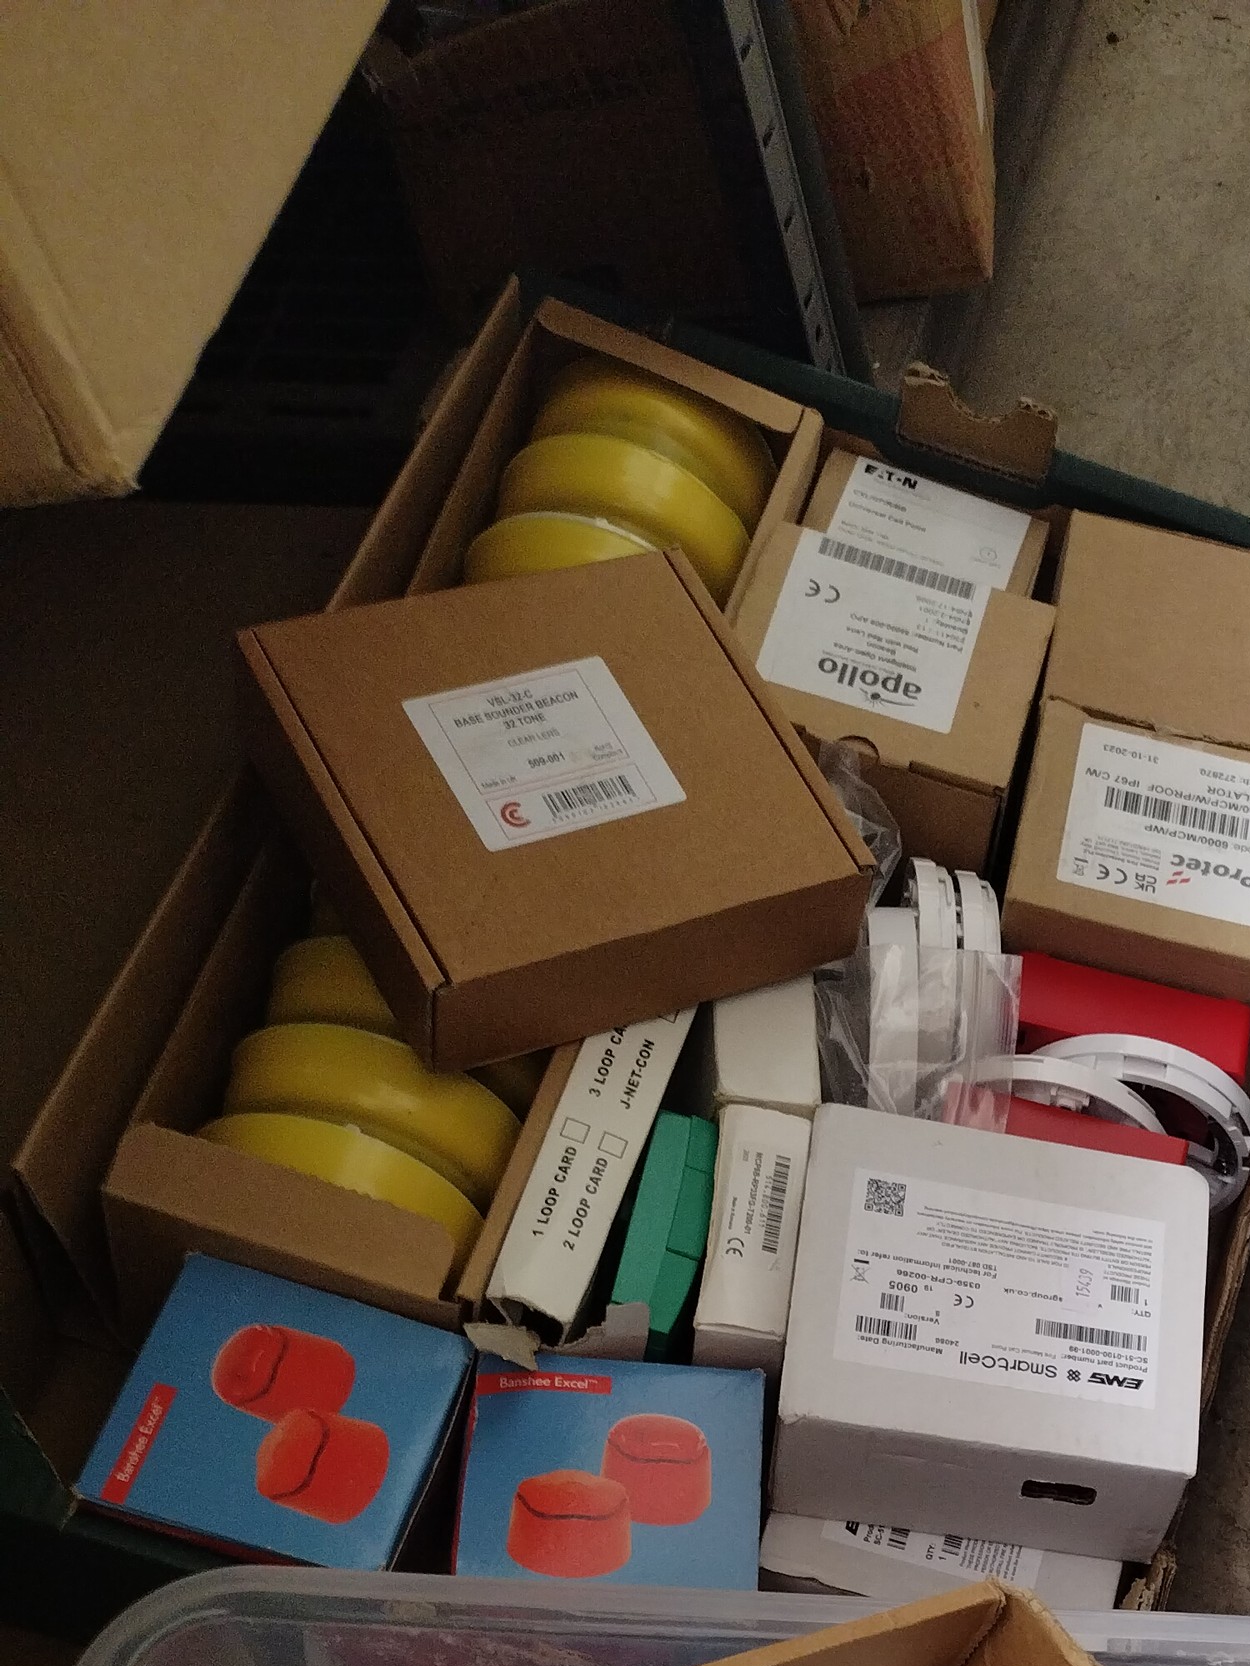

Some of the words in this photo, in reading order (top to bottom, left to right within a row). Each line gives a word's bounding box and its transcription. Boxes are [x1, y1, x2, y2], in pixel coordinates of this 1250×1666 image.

[814, 654, 924, 703] apollo
[454, 713, 484, 728] BASE
[484, 700, 534, 721] SOUNDER
[535, 690, 578, 709] BEACON
[503, 718, 518, 730] 32
[518, 712, 545, 726] TONE
[1102, 744, 1159, 763] 31-10-2023
[1084, 767, 1110, 780] C/W
[1114, 775, 1140, 787] IP67
[1143, 823, 1229, 849] 6000/MCP/WP
[608, 1020, 628, 1046] CA
[592, 1047, 618, 1085] LOOP
[617, 1038, 656, 1110] J-NET-CON
[587, 1086, 602, 1098] 3
[552, 1144, 578, 1184] CARD
[583, 1155, 609, 1195] CARD
[535, 1185, 561, 1225] LOOP
[566, 1197, 593, 1237] LOOP
[531, 1228, 545, 1239] 1
[561, 1238, 576, 1251] 2
[856, 1249, 869, 1257] to:
[870, 1251, 890, 1260] refer
[891, 1254, 941, 1269] information
[947, 1257, 980, 1267] 087-0001
[981, 1262, 997, 1271] TSD
[942, 1263, 981, 1276] technical
[982, 1269, 997, 1278] For
[895, 1268, 981, 1289] 0359-CPR-00266
[887, 1280, 918, 1293] 0905
[903, 1312, 940, 1324] Version:
[1130, 1308, 1151, 1317] QTY:
[856, 1334, 879, 1344] Date:
[880, 1337, 943, 1355] Manufacturing
[957, 1350, 1058, 1378] SmartCell
[1060, 1352, 1095, 1364] number:
[1096, 1356, 1113, 1367] part
[1114, 1360, 1148, 1373] Product
[499, 1375, 550, 1390] Banshee
[1087, 1371, 1144, 1390] EMS
[114, 1434, 148, 1483] Banshee
[925, 1542, 935, 1560] QTY:
